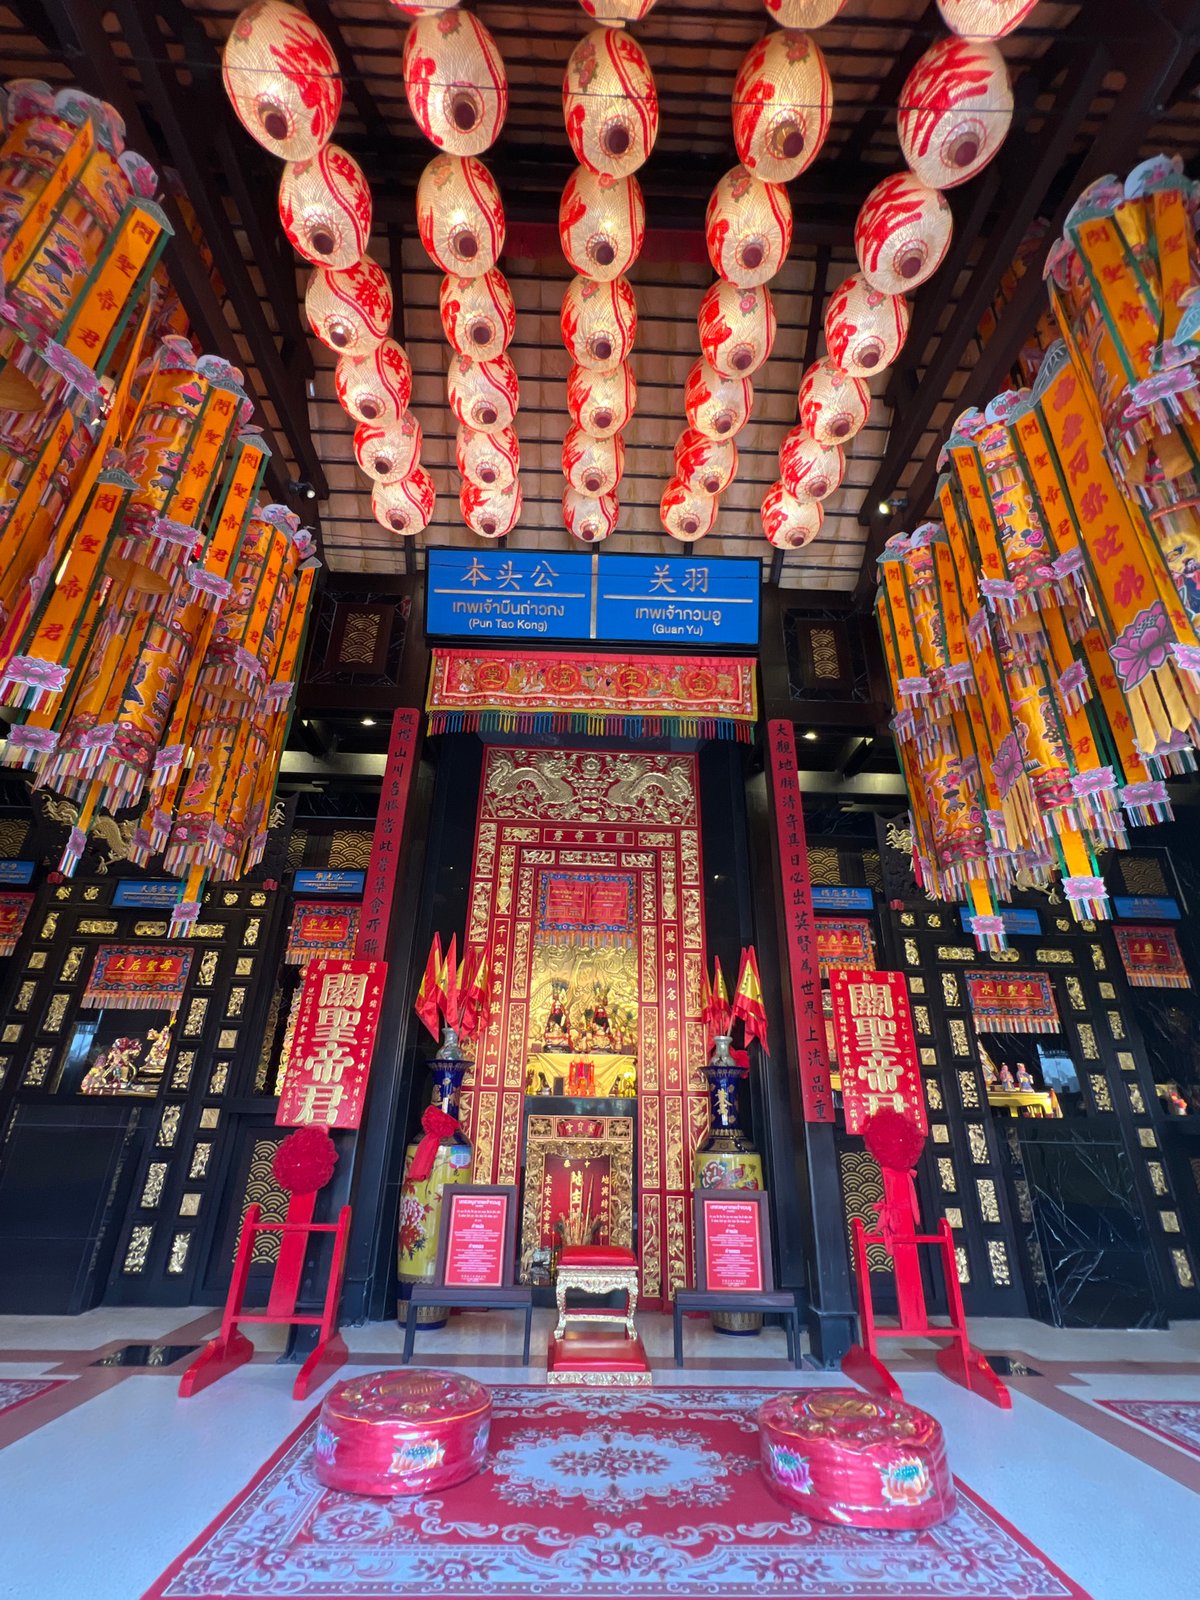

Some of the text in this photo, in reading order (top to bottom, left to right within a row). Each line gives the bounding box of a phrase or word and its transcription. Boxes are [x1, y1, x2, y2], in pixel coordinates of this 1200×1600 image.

[460, 556, 560, 590] 本头公
[648, 564, 709, 594] 关羽
[468, 618, 548, 632] (Pun Tao Kong)
[635, 604, 722, 626] เทพเจ้ากวนอู
[652, 623, 704, 637] (Guan Yu)
[292, 972, 369, 1126] 關聖帝君
